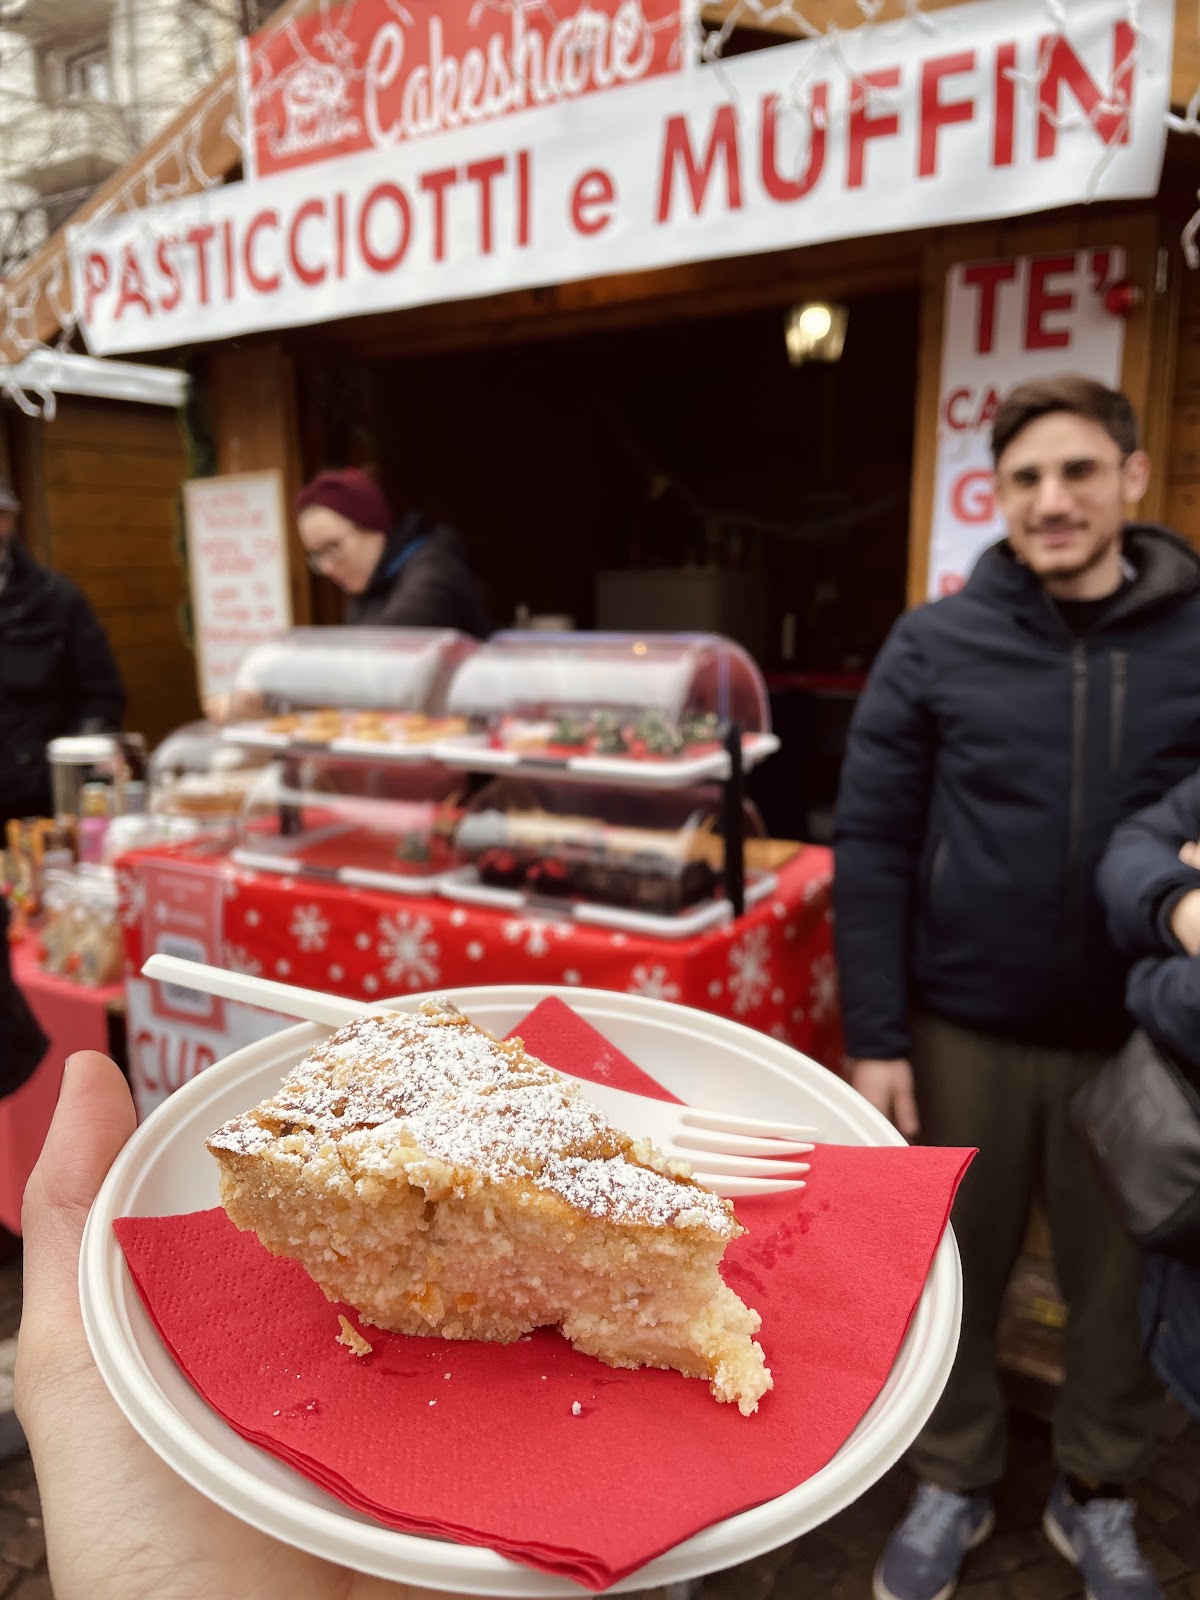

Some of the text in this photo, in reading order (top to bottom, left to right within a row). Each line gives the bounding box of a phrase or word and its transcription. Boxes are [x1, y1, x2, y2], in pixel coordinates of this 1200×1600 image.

[84, 19, 1138, 325] PASTICCIOTTI e MUFFIN
[364, 1, 654, 149] Cakeshare
